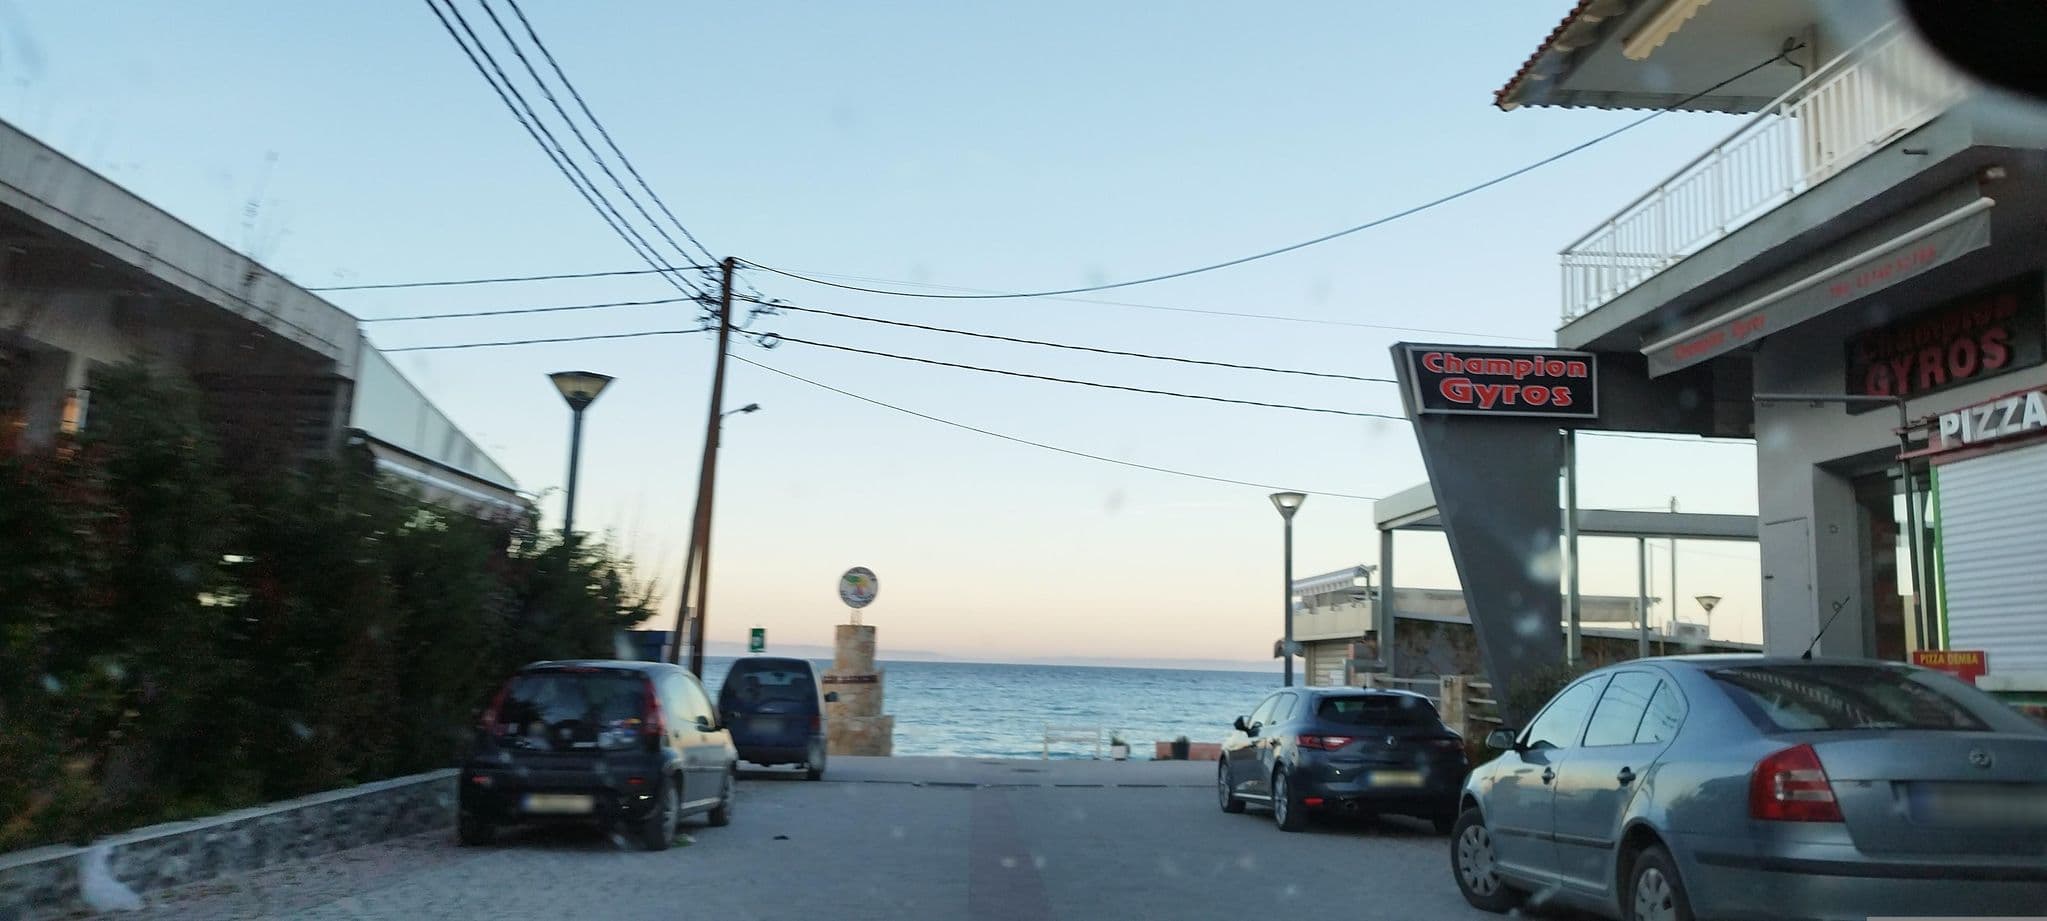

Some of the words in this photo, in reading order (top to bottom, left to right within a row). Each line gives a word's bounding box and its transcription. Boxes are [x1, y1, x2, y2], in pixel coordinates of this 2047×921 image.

[1422, 352, 1588, 379] Champion
[1865, 327, 2008, 397] GYROS
[1439, 377, 1573, 409] Gyros
[1939, 390, 2047, 449] PIZZA
[1920, 652, 1945, 665] PIZZA
